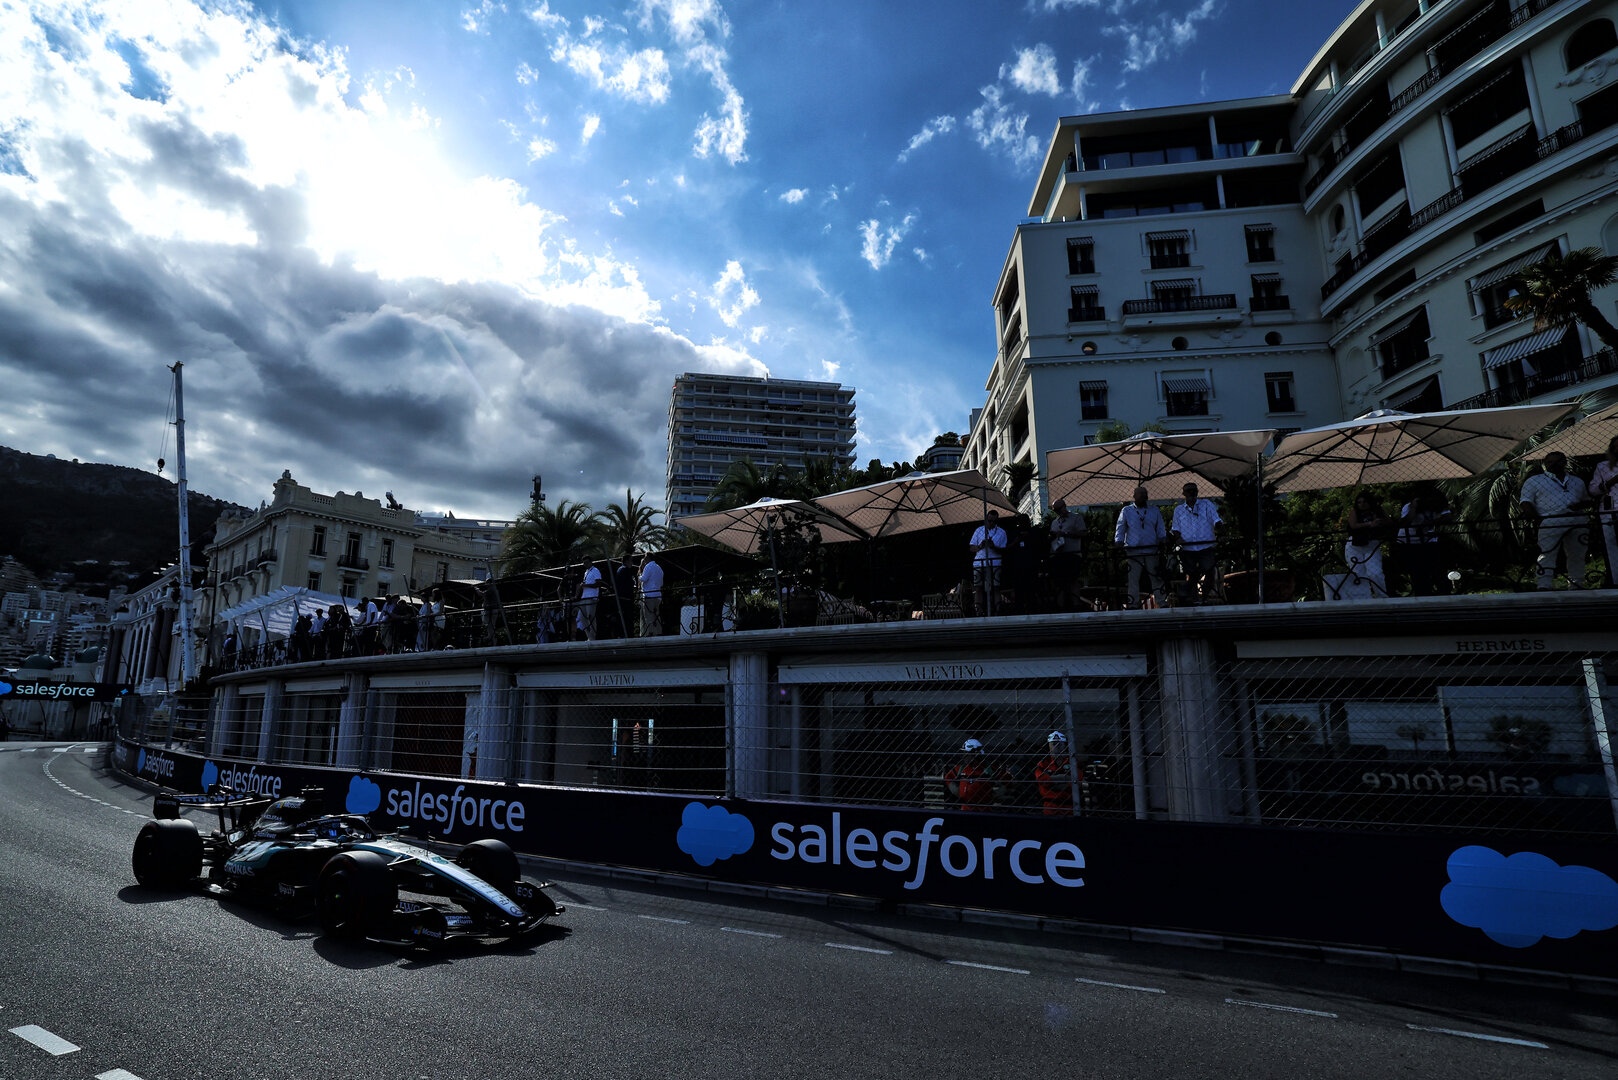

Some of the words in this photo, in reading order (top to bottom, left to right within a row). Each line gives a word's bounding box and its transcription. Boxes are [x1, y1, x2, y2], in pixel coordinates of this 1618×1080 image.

[589, 674, 635, 686] VALENTINO
[905, 664, 984, 680] VALENTINO
[16, 682, 96, 699] salesforce
[145, 750, 175, 780] salesforce
[219, 763, 282, 799] salesforce
[386, 781, 526, 835] salesforce
[770, 811, 1087, 891] salesforce
